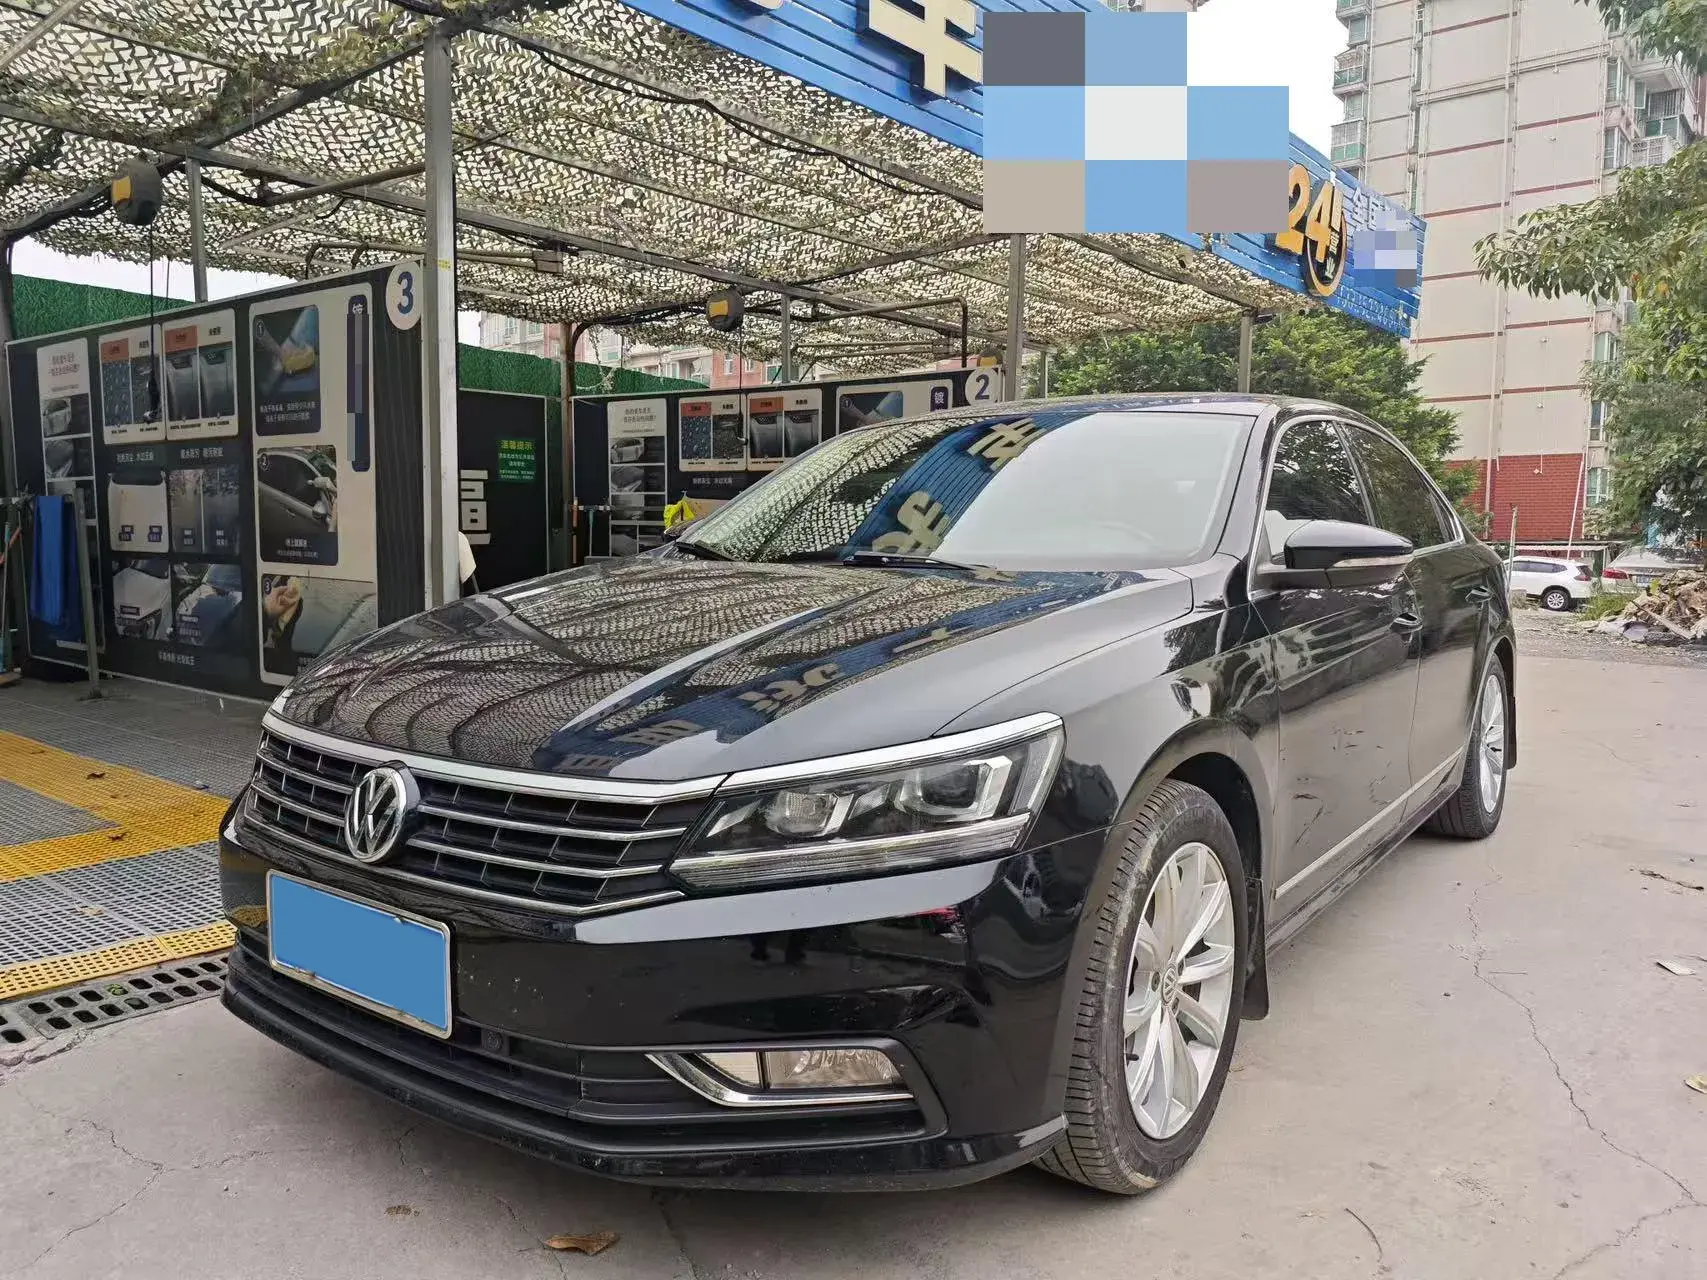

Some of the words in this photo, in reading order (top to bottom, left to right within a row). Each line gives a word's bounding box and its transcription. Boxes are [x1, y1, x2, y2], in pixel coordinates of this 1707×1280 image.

[397, 271, 413, 314] 3
[975, 374, 990, 400] 2
[500, 440, 533, 450] 温馨提示
